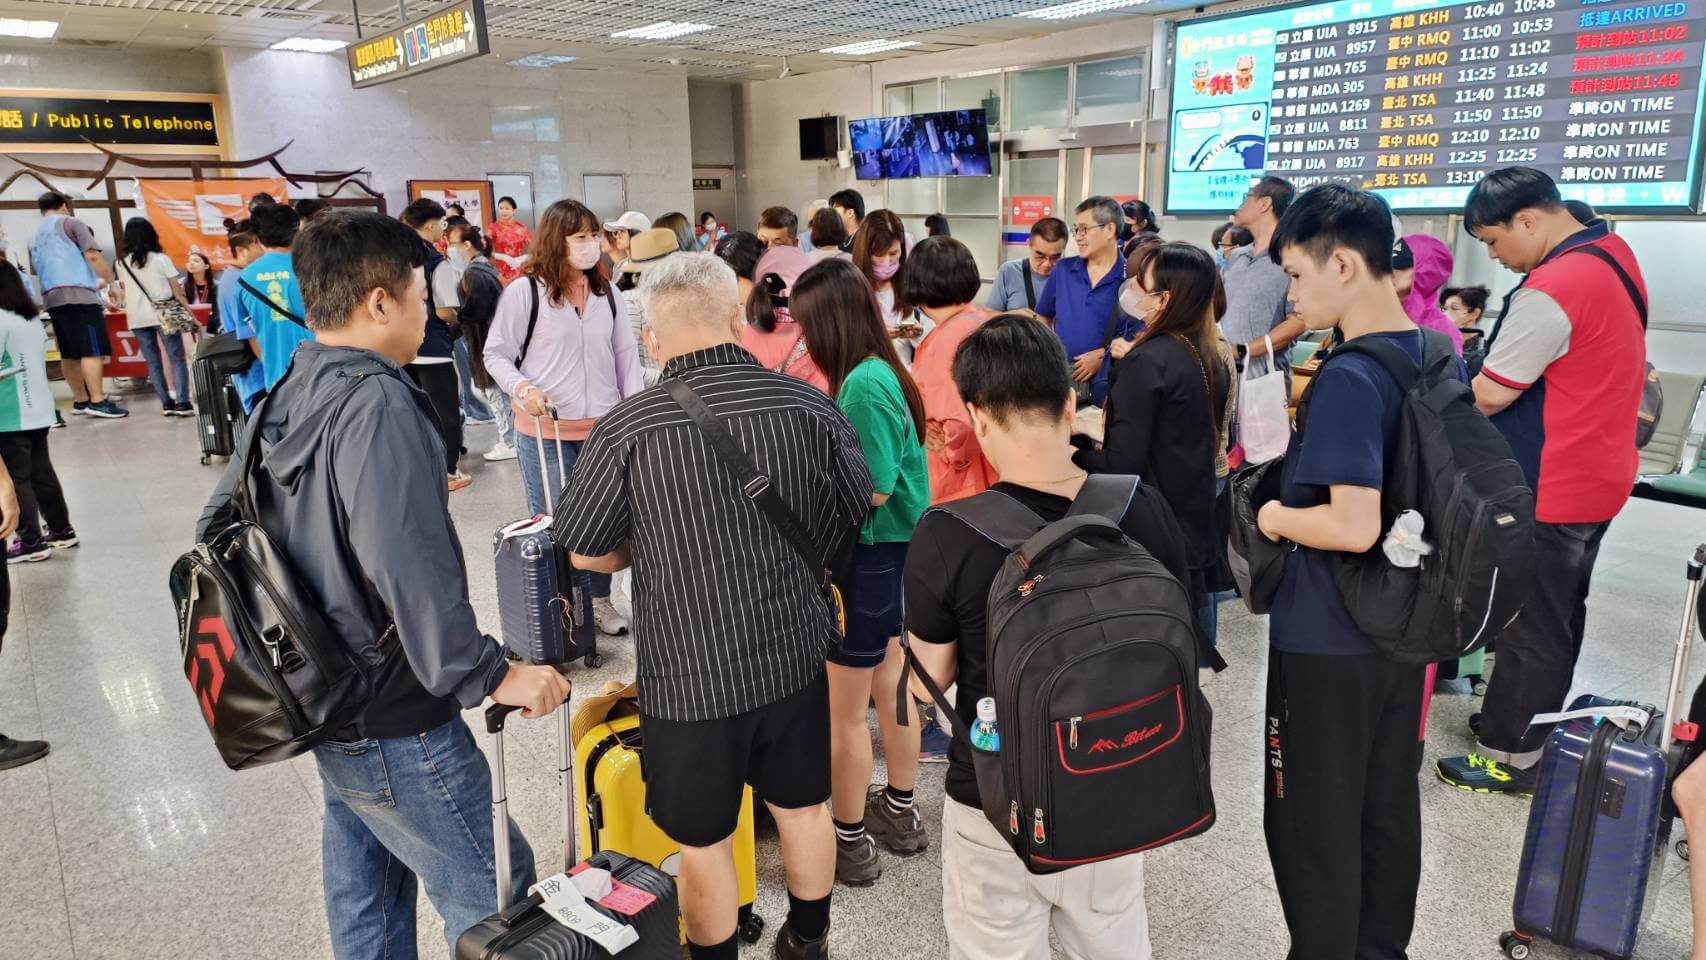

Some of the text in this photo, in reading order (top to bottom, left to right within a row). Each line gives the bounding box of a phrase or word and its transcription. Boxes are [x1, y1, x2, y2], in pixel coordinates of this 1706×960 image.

[1315, 46, 1336, 59] UIA
[1346, 40, 1376, 55] 8957
[1417, 30, 1450, 46] RMQ
[1462, 24, 1501, 41] 11:00
[1512, 18, 1553, 35] 10:53
[1317, 26, 1337, 40] UIA
[1348, 20, 1378, 35] 8915
[1420, 10, 1450, 26] KHH
[1464, 3, 1504, 20] 10:40
[1313, 64, 1341, 77] MDA
[1344, 60, 1366, 74] 765
[1415, 51, 1448, 66] RMQ
[1460, 45, 1499, 61] 11:10
[1509, 40, 1550, 57] 11:02
[1311, 83, 1339, 96] MDA
[1342, 80, 1365, 93] 305
[1413, 72, 1443, 87] KHH
[1457, 67, 1496, 82] 11:25
[1506, 62, 1547, 78] 11:24
[1308, 121, 1329, 133] UIA
[1339, 118, 1368, 131] 8811
[1409, 113, 1434, 126] TSA
[1453, 109, 1492, 123] 11:50
[1502, 105, 1542, 121] 11:50
[1631, 96, 1674, 111] TIME
[1310, 103, 1338, 115] MDA
[1340, 99, 1370, 112] 1269
[1411, 93, 1436, 107] TSA
[1455, 88, 1494, 103] 11:40
[1504, 84, 1545, 100] 11:48
[0, 110, 23, 128] 話
[48, 113, 114, 129] Public
[121, 114, 214, 132] Telephone
[1306, 140, 1335, 152] MDA
[1338, 137, 1360, 150] 763
[1407, 132, 1440, 147] RMQ
[1450, 129, 1489, 144] 12:10
[1499, 126, 1540, 141] 12:10
[1628, 120, 1671, 134] TIME
[1305, 158, 1326, 169] UIA
[1336, 156, 1365, 168] 8917
[1404, 153, 1434, 165] KHH
[1448, 150, 1487, 164] 12:25
[1496, 148, 1536, 163] 12:25
[1625, 142, 1668, 157] TIME
[1403, 172, 1428, 185] TSA
[1446, 171, 1485, 184] 13:10
[1622, 165, 1664, 179] TIME
[1268, 716, 1283, 769] PANTS
